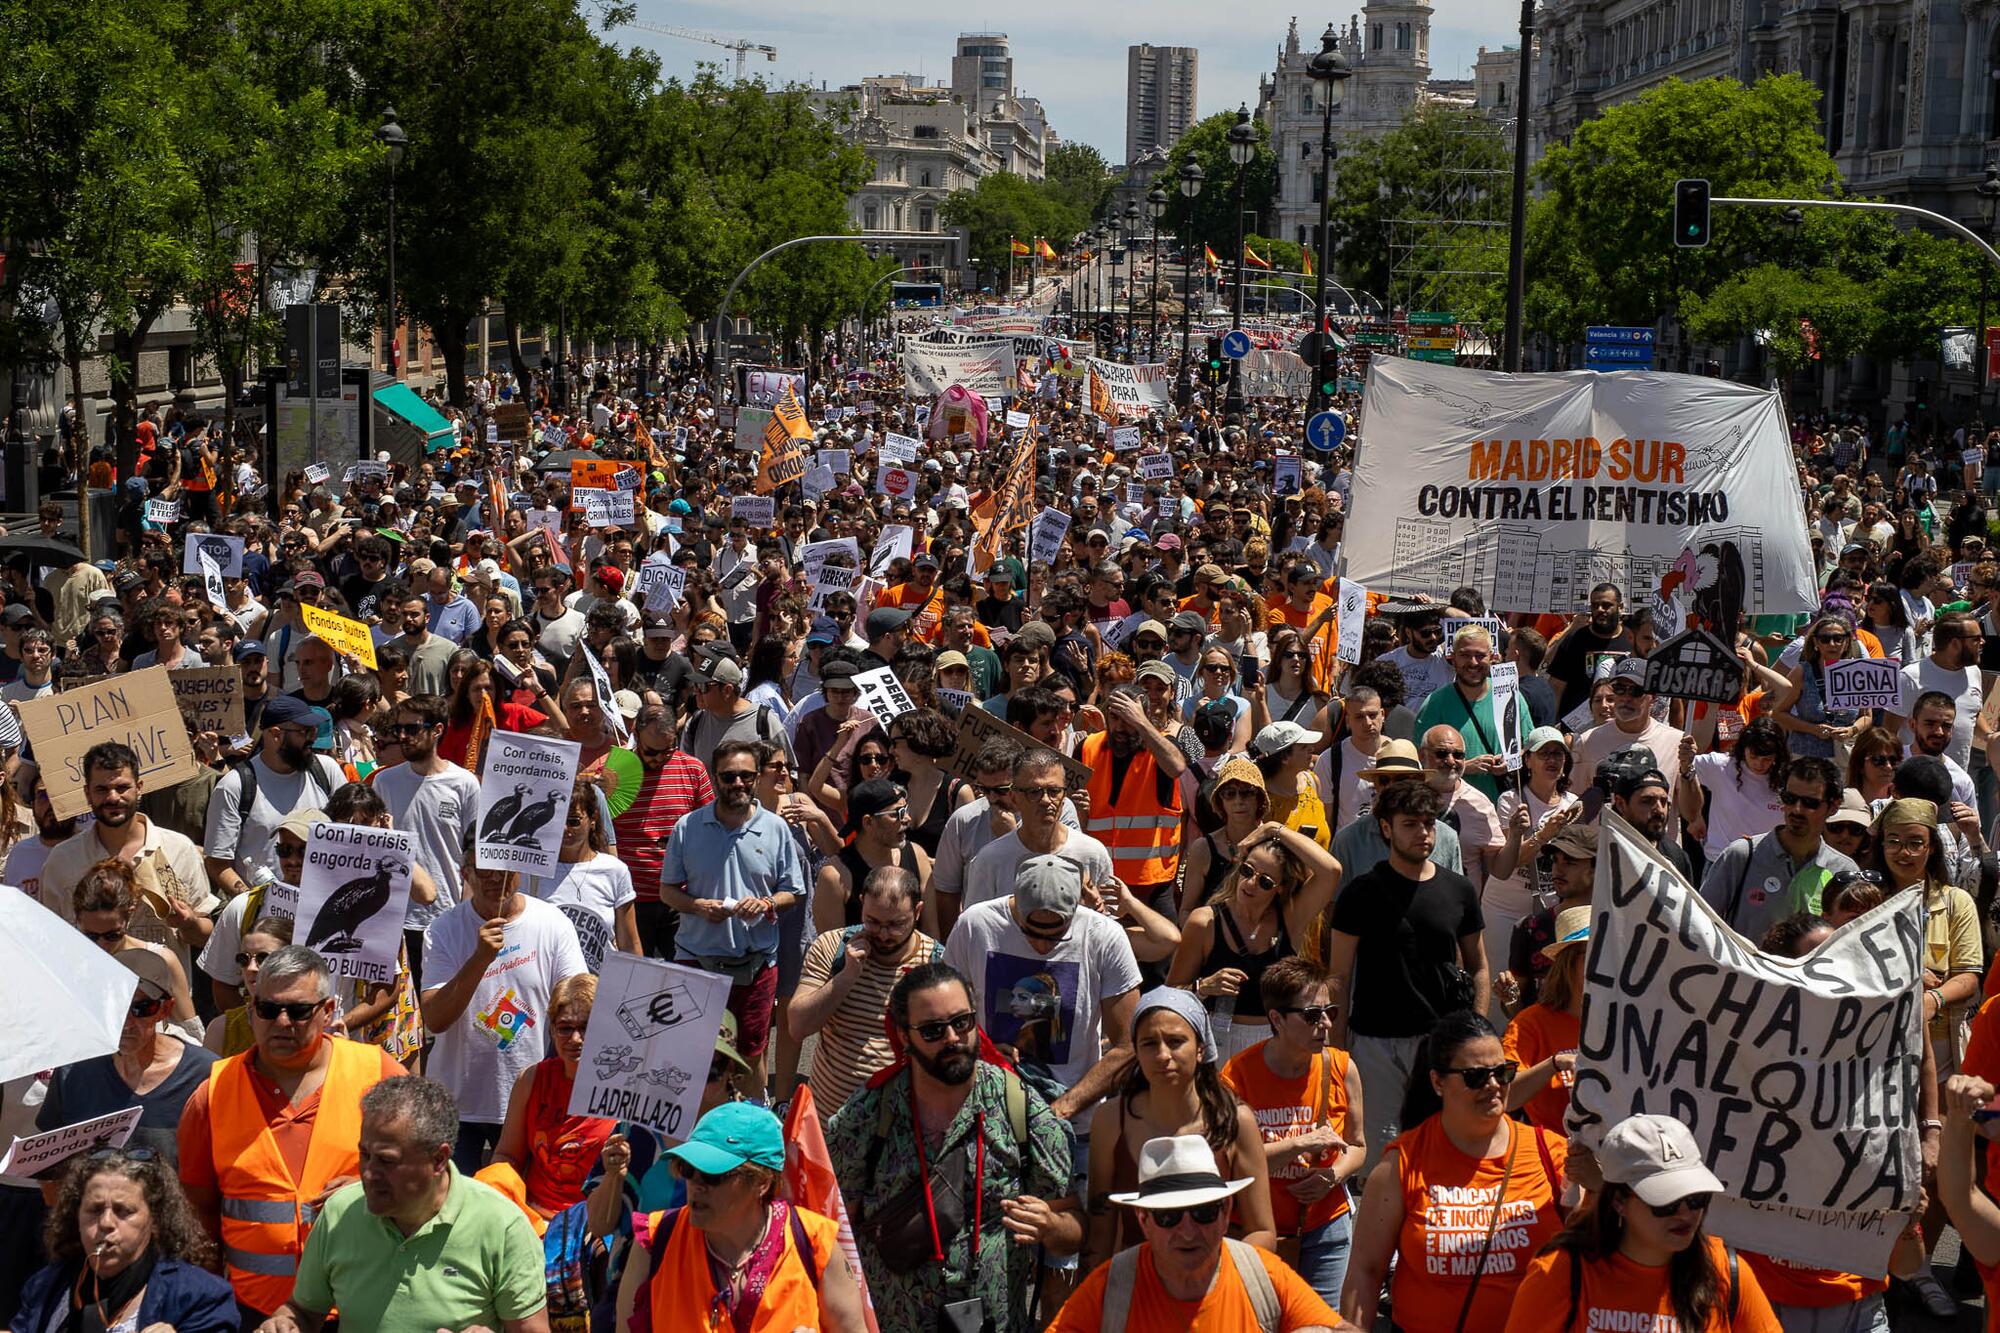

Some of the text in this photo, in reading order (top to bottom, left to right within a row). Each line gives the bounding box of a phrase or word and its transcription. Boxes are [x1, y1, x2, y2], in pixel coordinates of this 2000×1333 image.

[987, 336, 1044, 357] CIOS
[1110, 366, 1135, 384] PARA
[1132, 365, 1166, 383] VIVIR
[1111, 384, 1140, 401] PARA
[1144, 456, 1169, 465] DERECHO
[1468, 437, 1687, 485] MADRID SUR
[886, 475, 907, 484] STOP
[588, 498, 611, 509] Fondos
[1417, 485, 1729, 527] CONTRA EL RENTISMO
[643, 568, 682, 587] DIGNA
[813, 592, 820, 608] A
[1653, 593, 1677, 620] STOP
[861, 683, 876, 694] A
[1833, 670, 1895, 692] DIGNA
[56, 687, 130, 735] PLAN
[223, 698, 231, 712] Y
[1832, 694, 1899, 708] A JUSTO €
[503, 746, 565, 767] Con crisis,
[493, 762, 570, 782] engordamos.
[314, 823, 412, 855] Con la crisis,
[309, 851, 372, 871] engorda
[480, 847, 549, 867] FONDOS BUITRE.
[271, 882, 291, 901] Con
[271, 904, 295, 920] engo
[560, 906, 609, 948] ERECHO
[578, 930, 605, 964] CHO
[340, 957, 389, 983] BUITRE.
[1820, 992, 1917, 1058] POR
[587, 1086, 682, 1135] LADRILLAZO
[22, 1112, 133, 1152] Con la crisis,
[16, 1138, 90, 1164] engorda
[1659, 1131, 1685, 1163] A
[1824, 1129, 1905, 1211] YA
[1427, 1203, 1535, 1228] DE INQUIINAS
[1426, 1229, 1530, 1254] E INQUIINOS
[1426, 1255, 1448, 1275] DE
